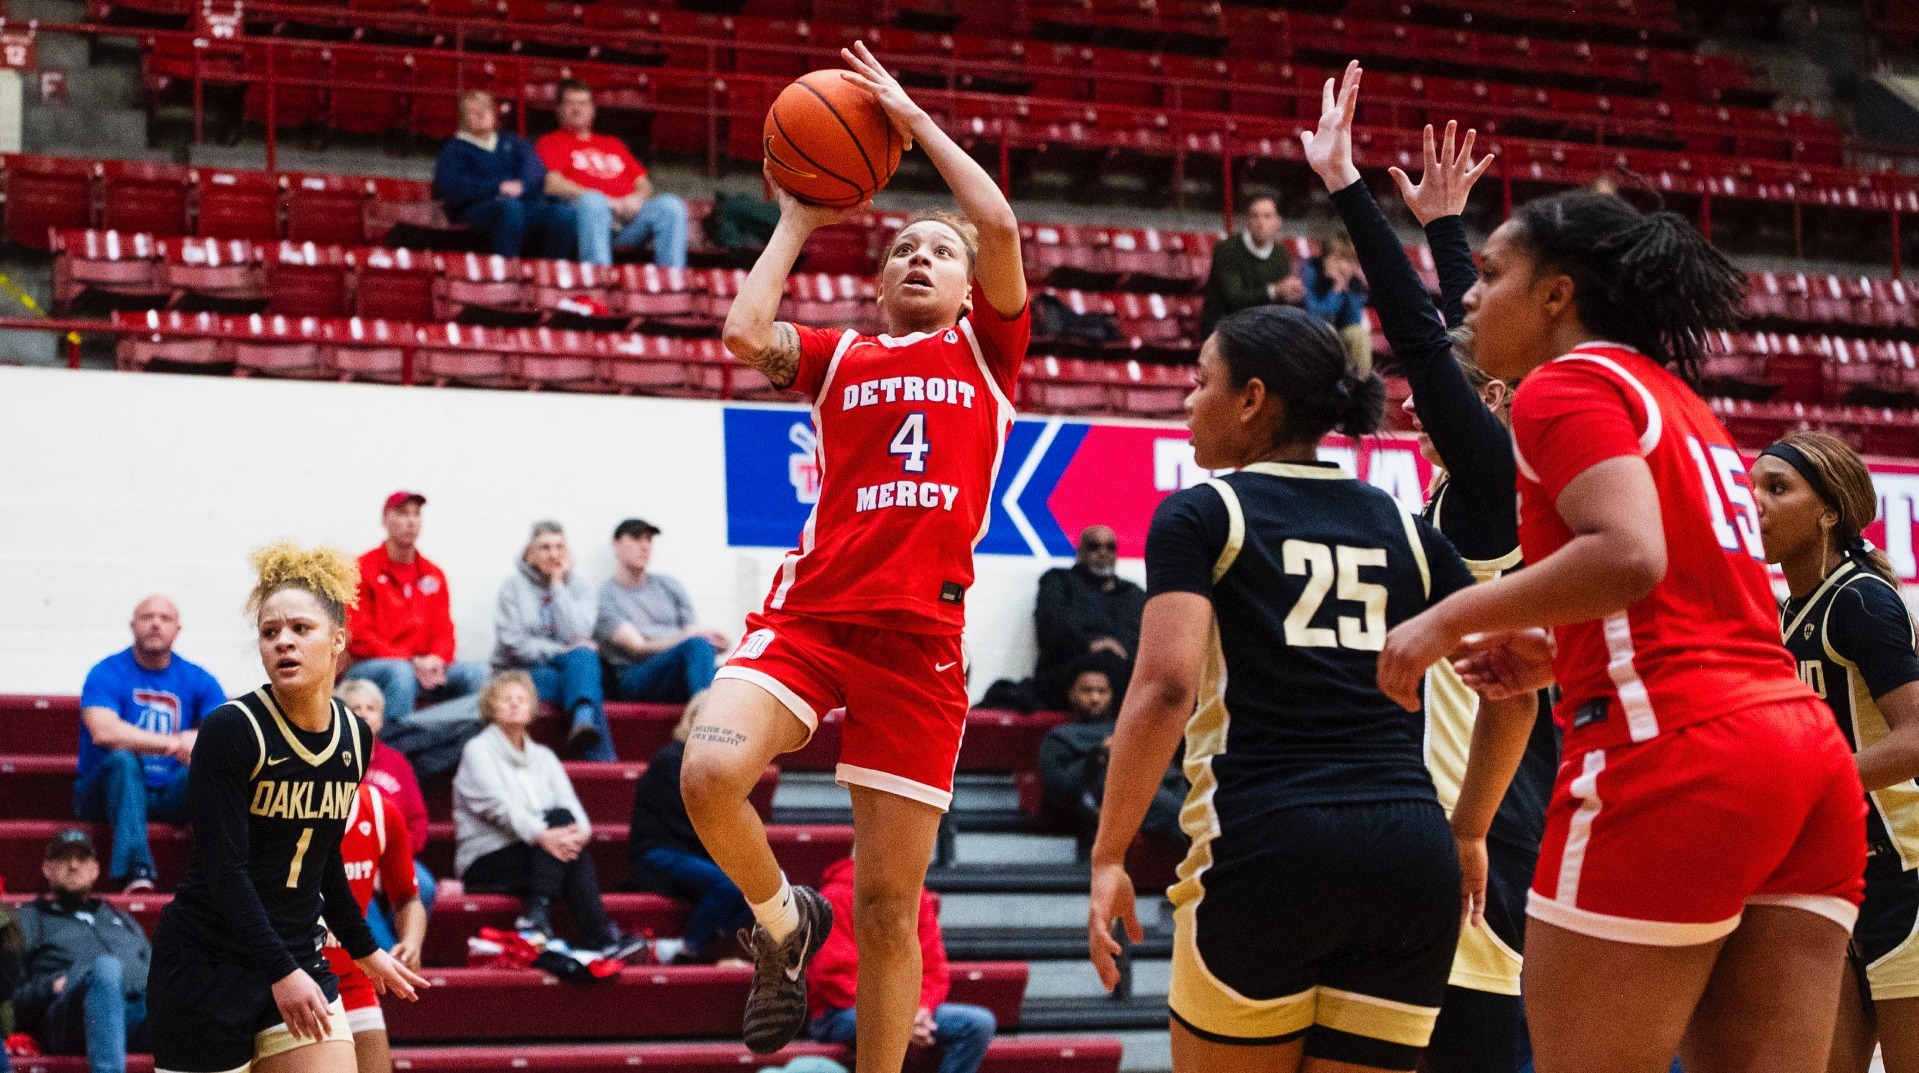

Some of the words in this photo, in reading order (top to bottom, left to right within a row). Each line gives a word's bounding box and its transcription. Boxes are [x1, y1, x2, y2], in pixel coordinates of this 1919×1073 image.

[842, 376, 976, 412] DETROIT
[888, 411, 931, 475] 4
[855, 480, 959, 513] MERCY
[1683, 434, 1768, 563] 15
[1281, 538, 1389, 652] 25
[285, 827, 314, 889] 1
